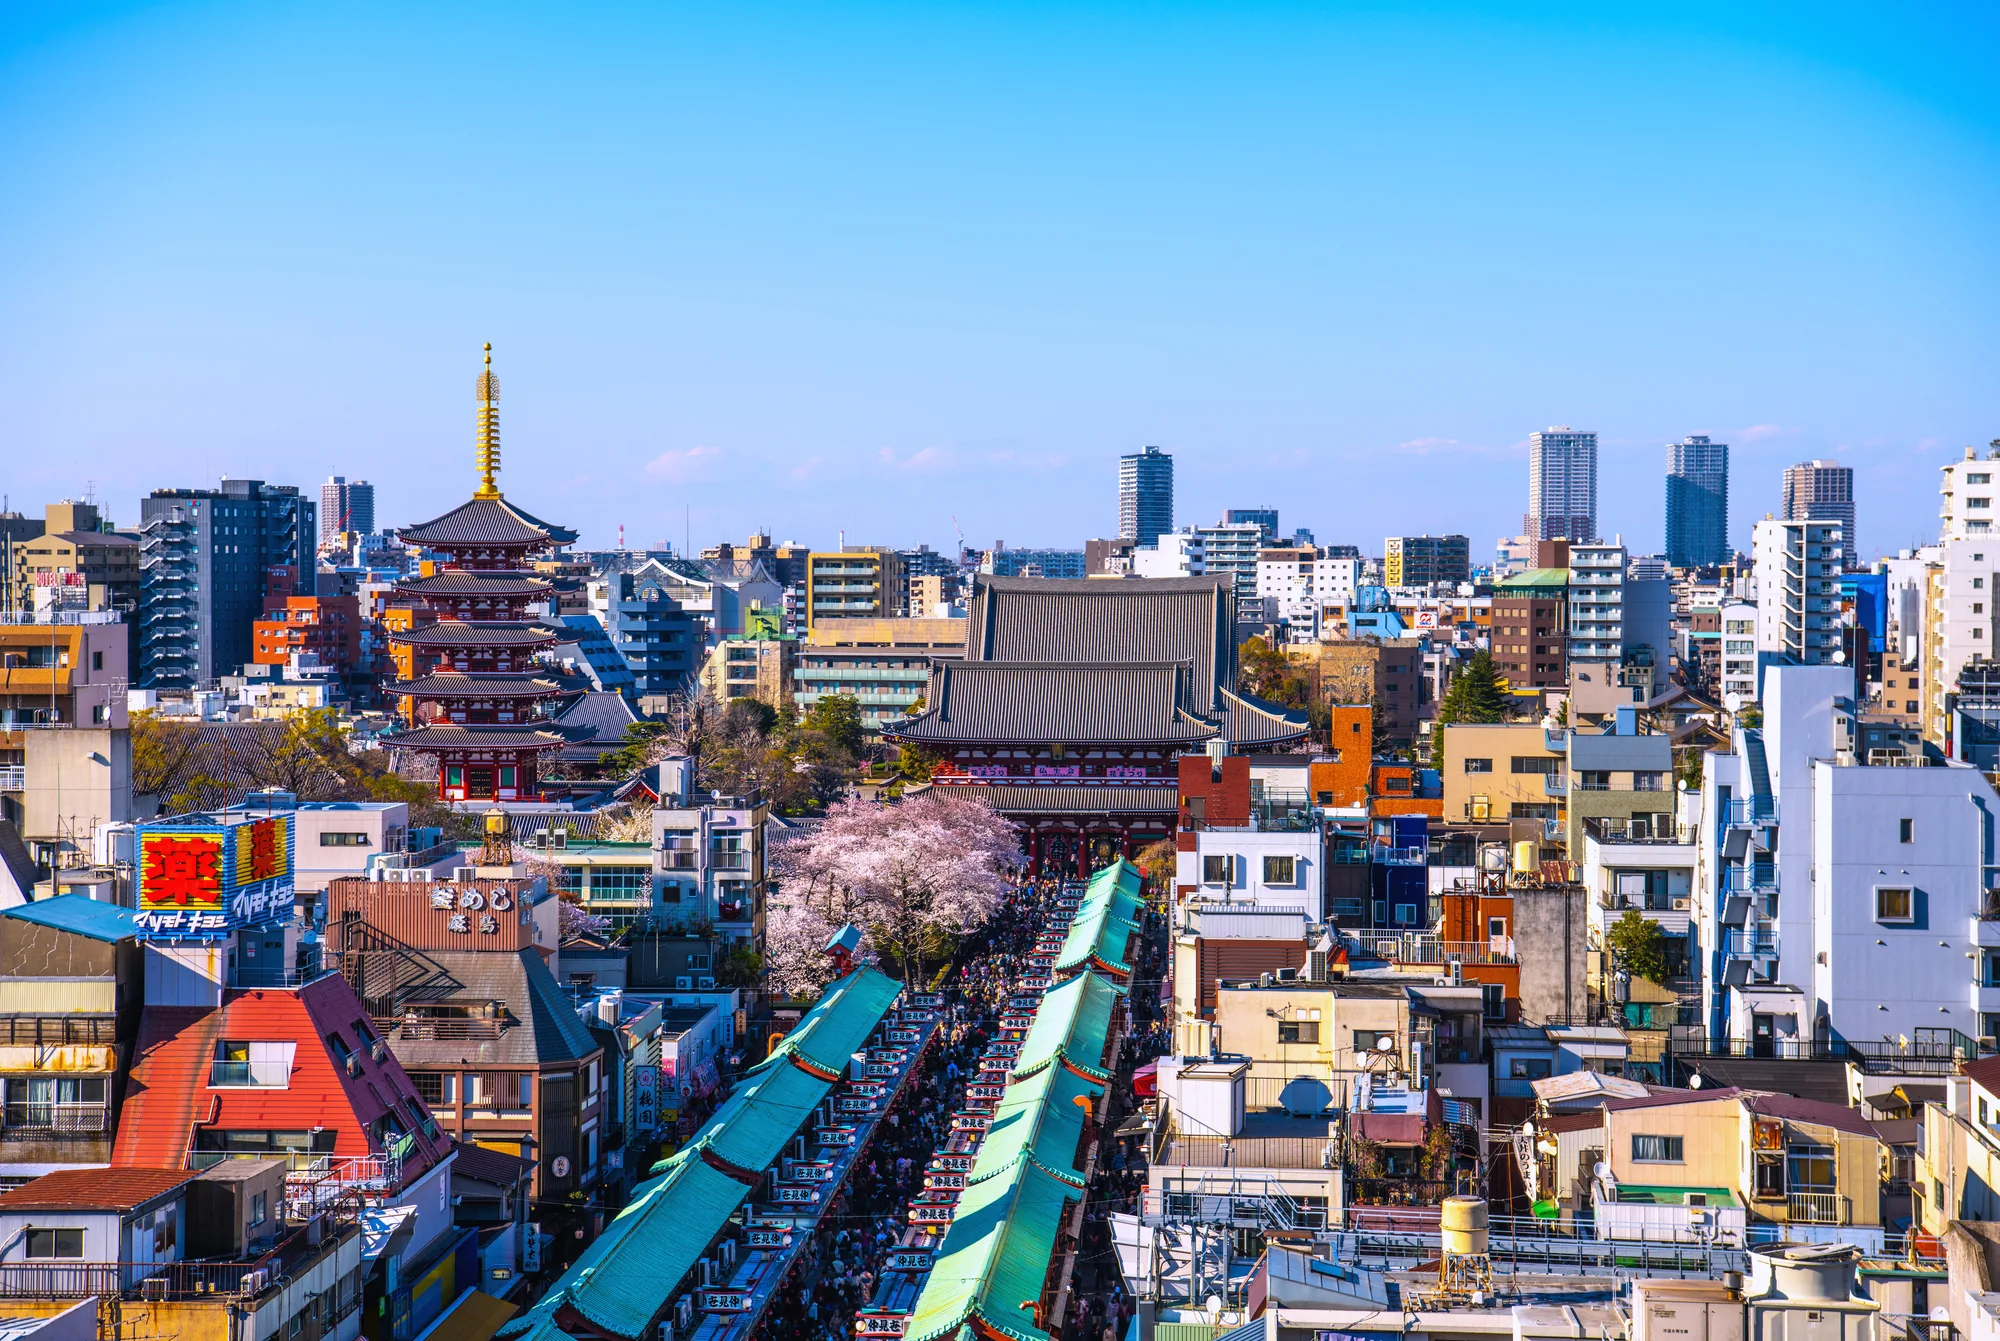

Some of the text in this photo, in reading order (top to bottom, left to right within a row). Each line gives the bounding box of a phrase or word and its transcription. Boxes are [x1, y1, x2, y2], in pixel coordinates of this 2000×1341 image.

[36, 572, 58, 586] HOTEL
[252, 818, 276, 880] 薬
[144, 838, 218, 904] 薬
[431, 886, 510, 910] 釜めし
[133, 910, 228, 932] マツモトキヨシ
[919, 1208, 948, 1220] 仲見世
[868, 1319, 900, 1331] 仲見世
